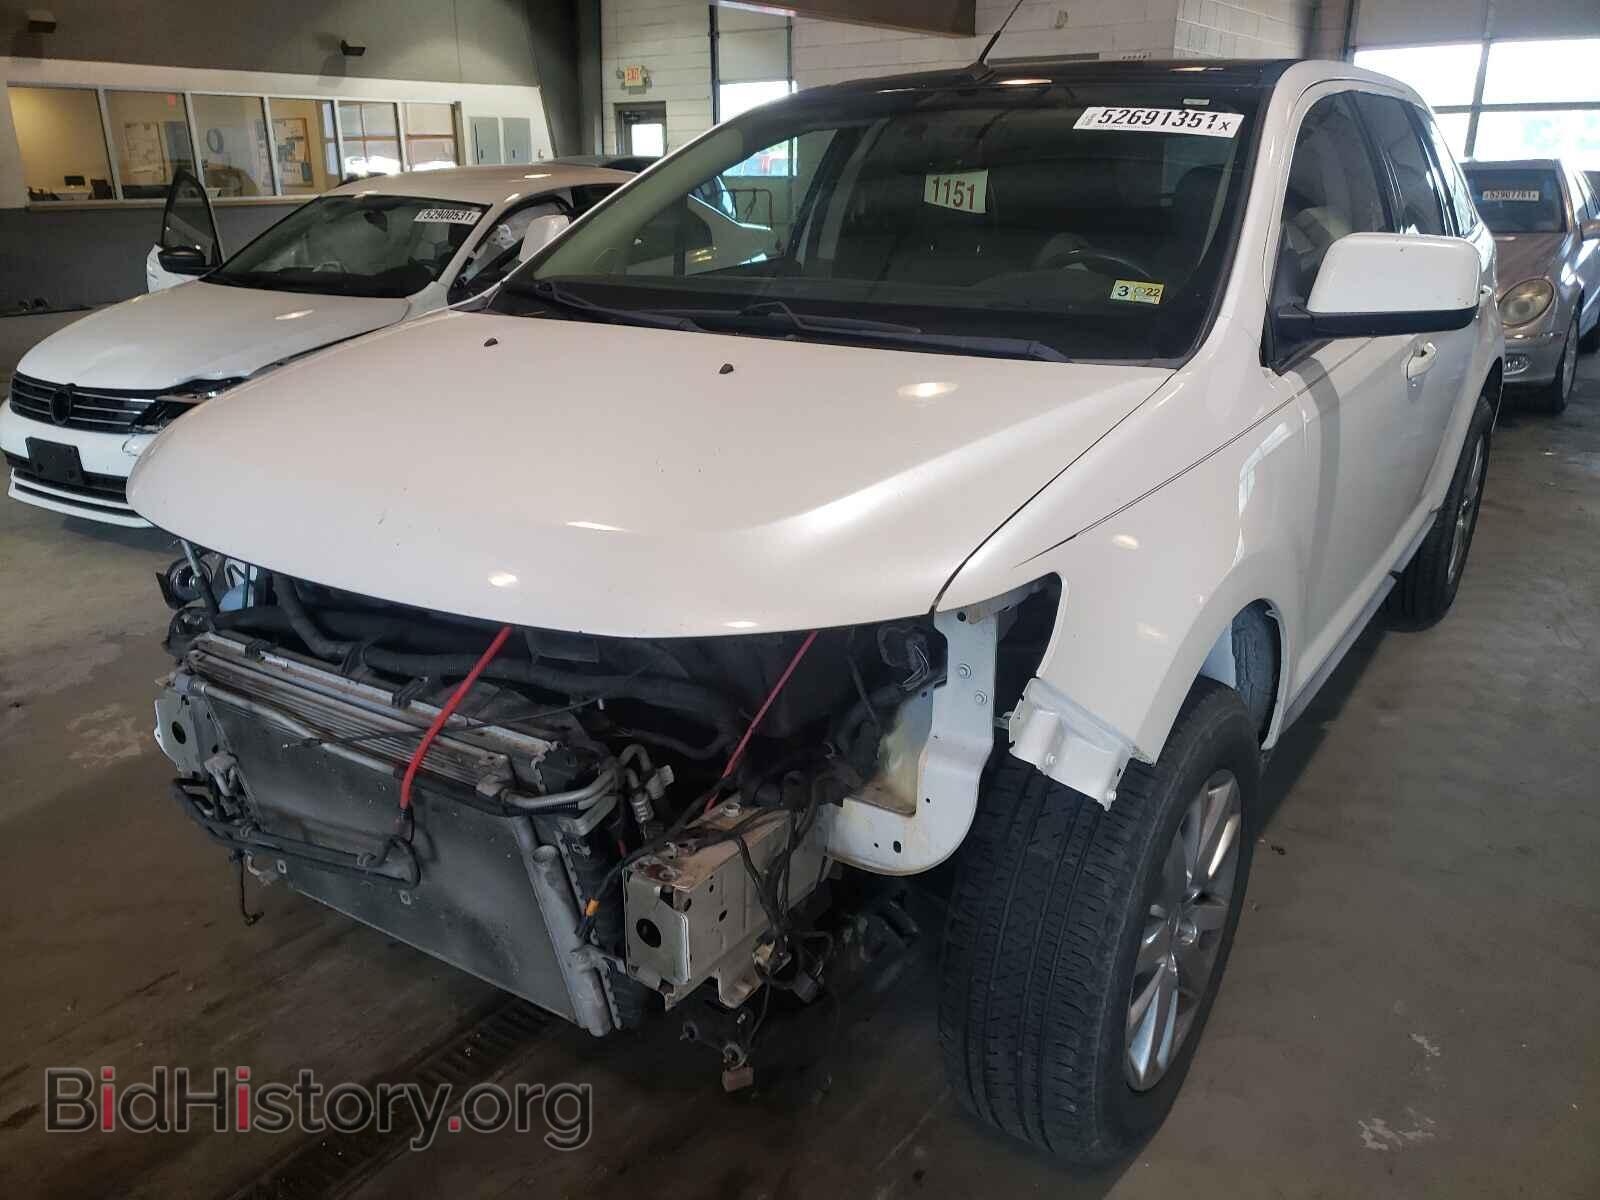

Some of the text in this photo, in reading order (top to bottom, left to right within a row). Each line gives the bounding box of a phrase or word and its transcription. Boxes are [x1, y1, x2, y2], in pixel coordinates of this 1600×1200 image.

[1097, 108, 1218, 130] 52691351
[932, 176, 976, 210] 1151
[1117, 285, 1161, 297] 3 22
